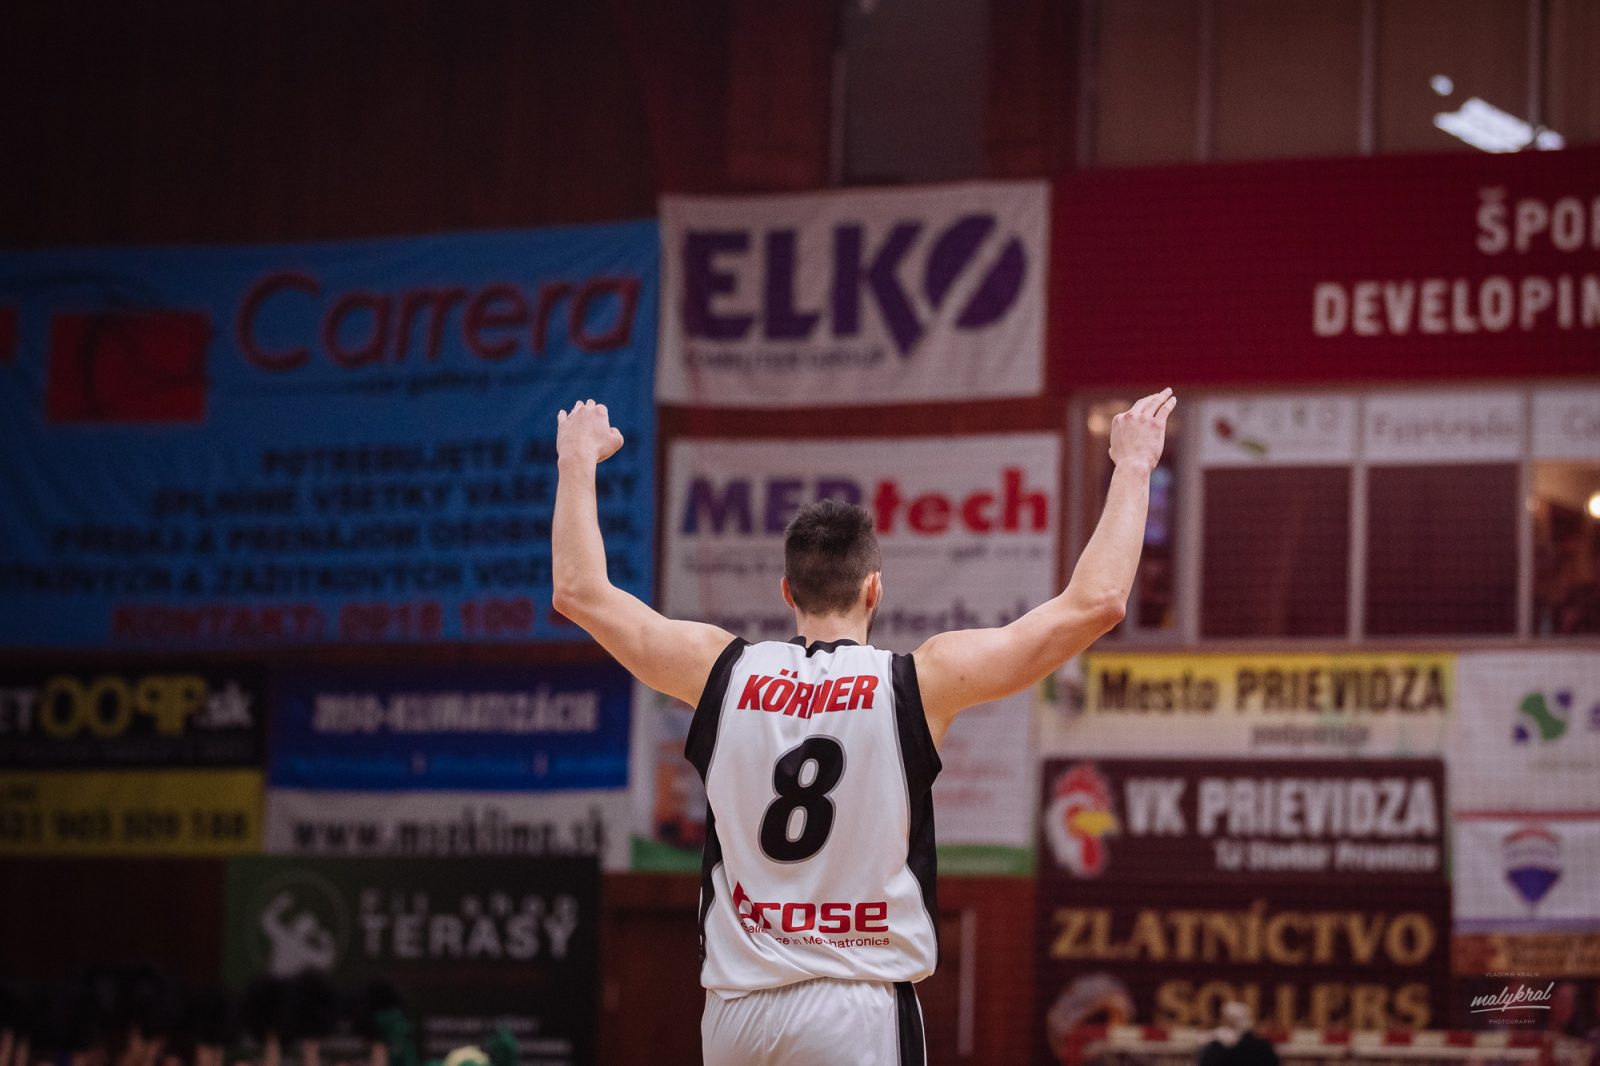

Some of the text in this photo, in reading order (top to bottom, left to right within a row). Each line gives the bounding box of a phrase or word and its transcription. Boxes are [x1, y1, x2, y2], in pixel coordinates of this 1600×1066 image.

[684, 214, 1027, 359] ELKO
[236, 269, 643, 373] Carrera
[737, 669, 879, 719] KÖRNER
[1235, 664, 1448, 714] PRIEVIDZA
[758, 734, 847, 864] 8
[1124, 776, 1438, 836] VK PRIEVIDZA
[358, 913, 578, 959] TERASY
[1049, 900, 1437, 965] ZLATNÍCTVO
